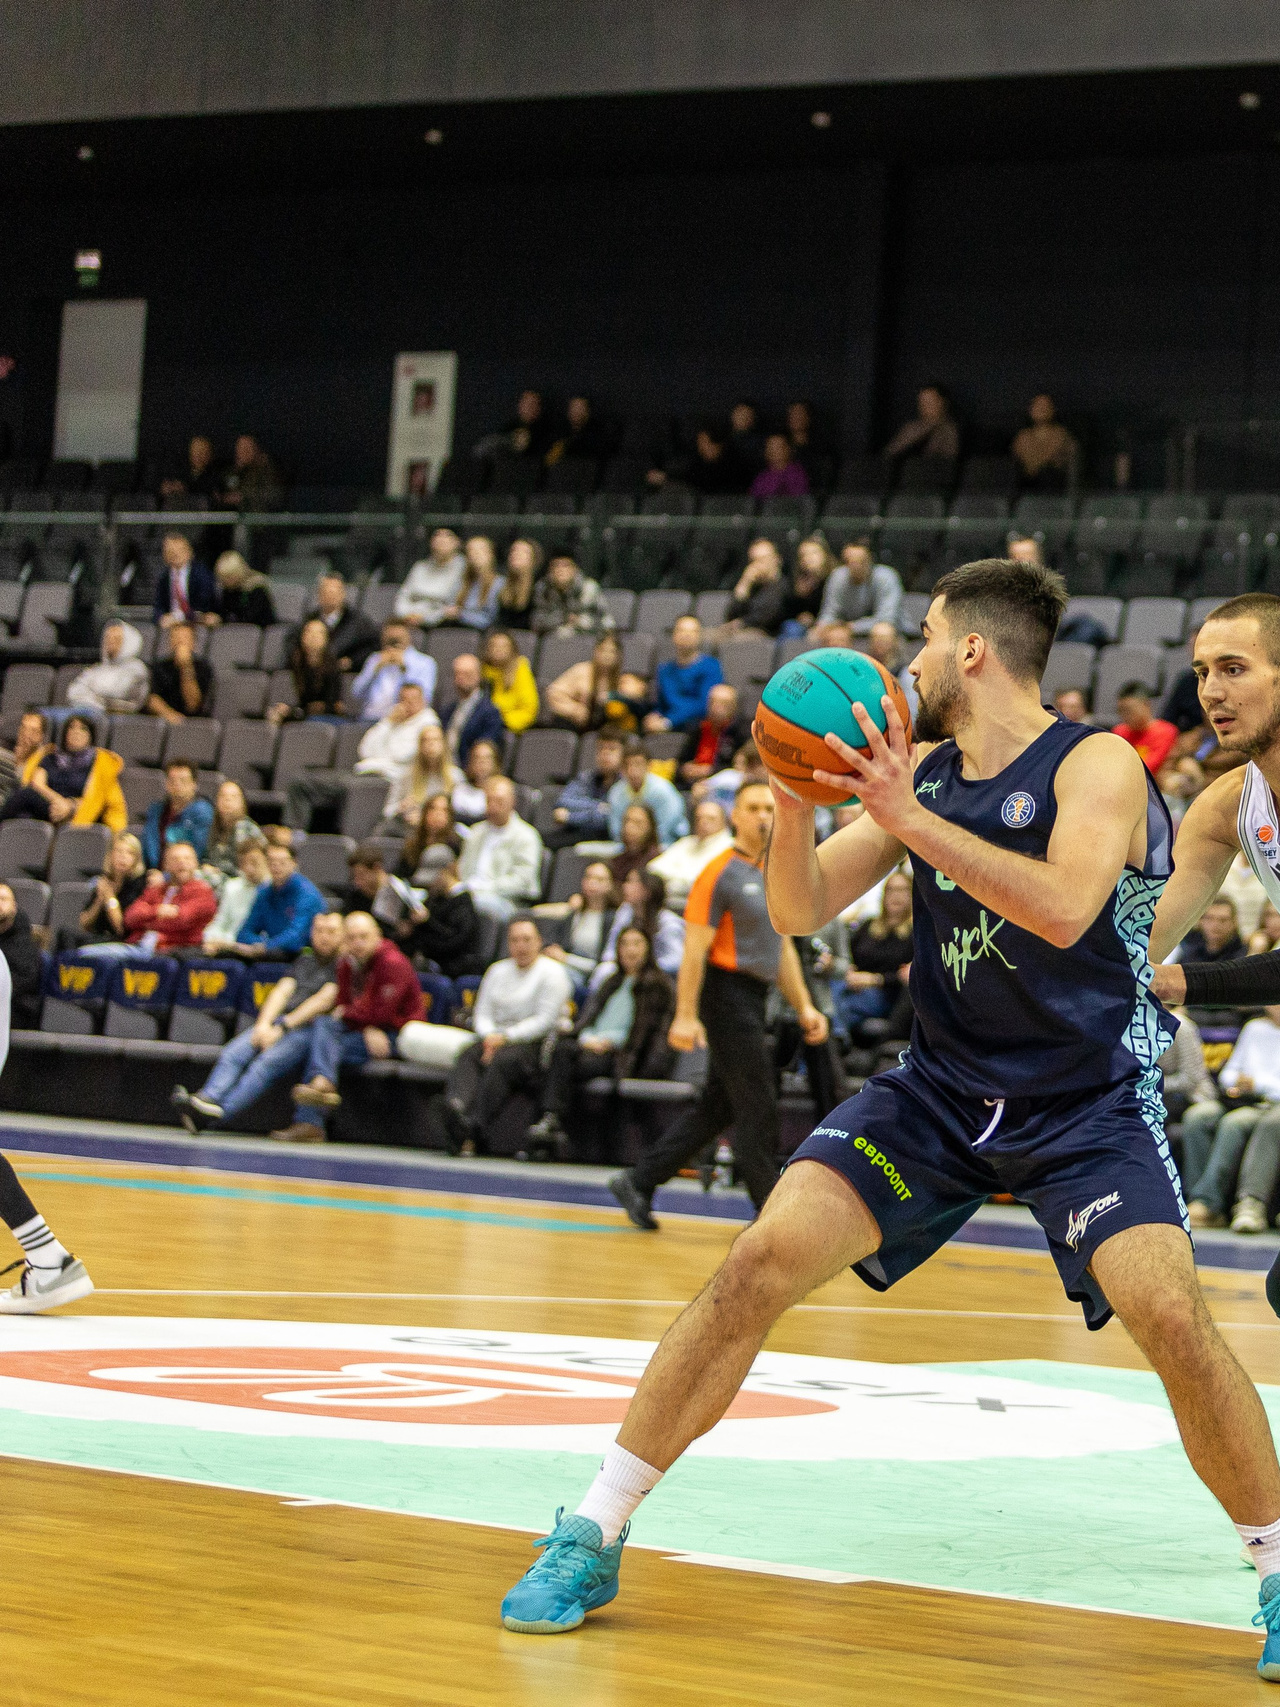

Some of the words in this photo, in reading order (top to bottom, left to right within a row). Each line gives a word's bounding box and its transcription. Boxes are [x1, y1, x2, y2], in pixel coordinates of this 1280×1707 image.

[59, 964, 95, 994] VIP
[123, 968, 160, 998] VIP
[189, 969, 227, 998] VIP
[853, 1136, 913, 1201] евроопт
